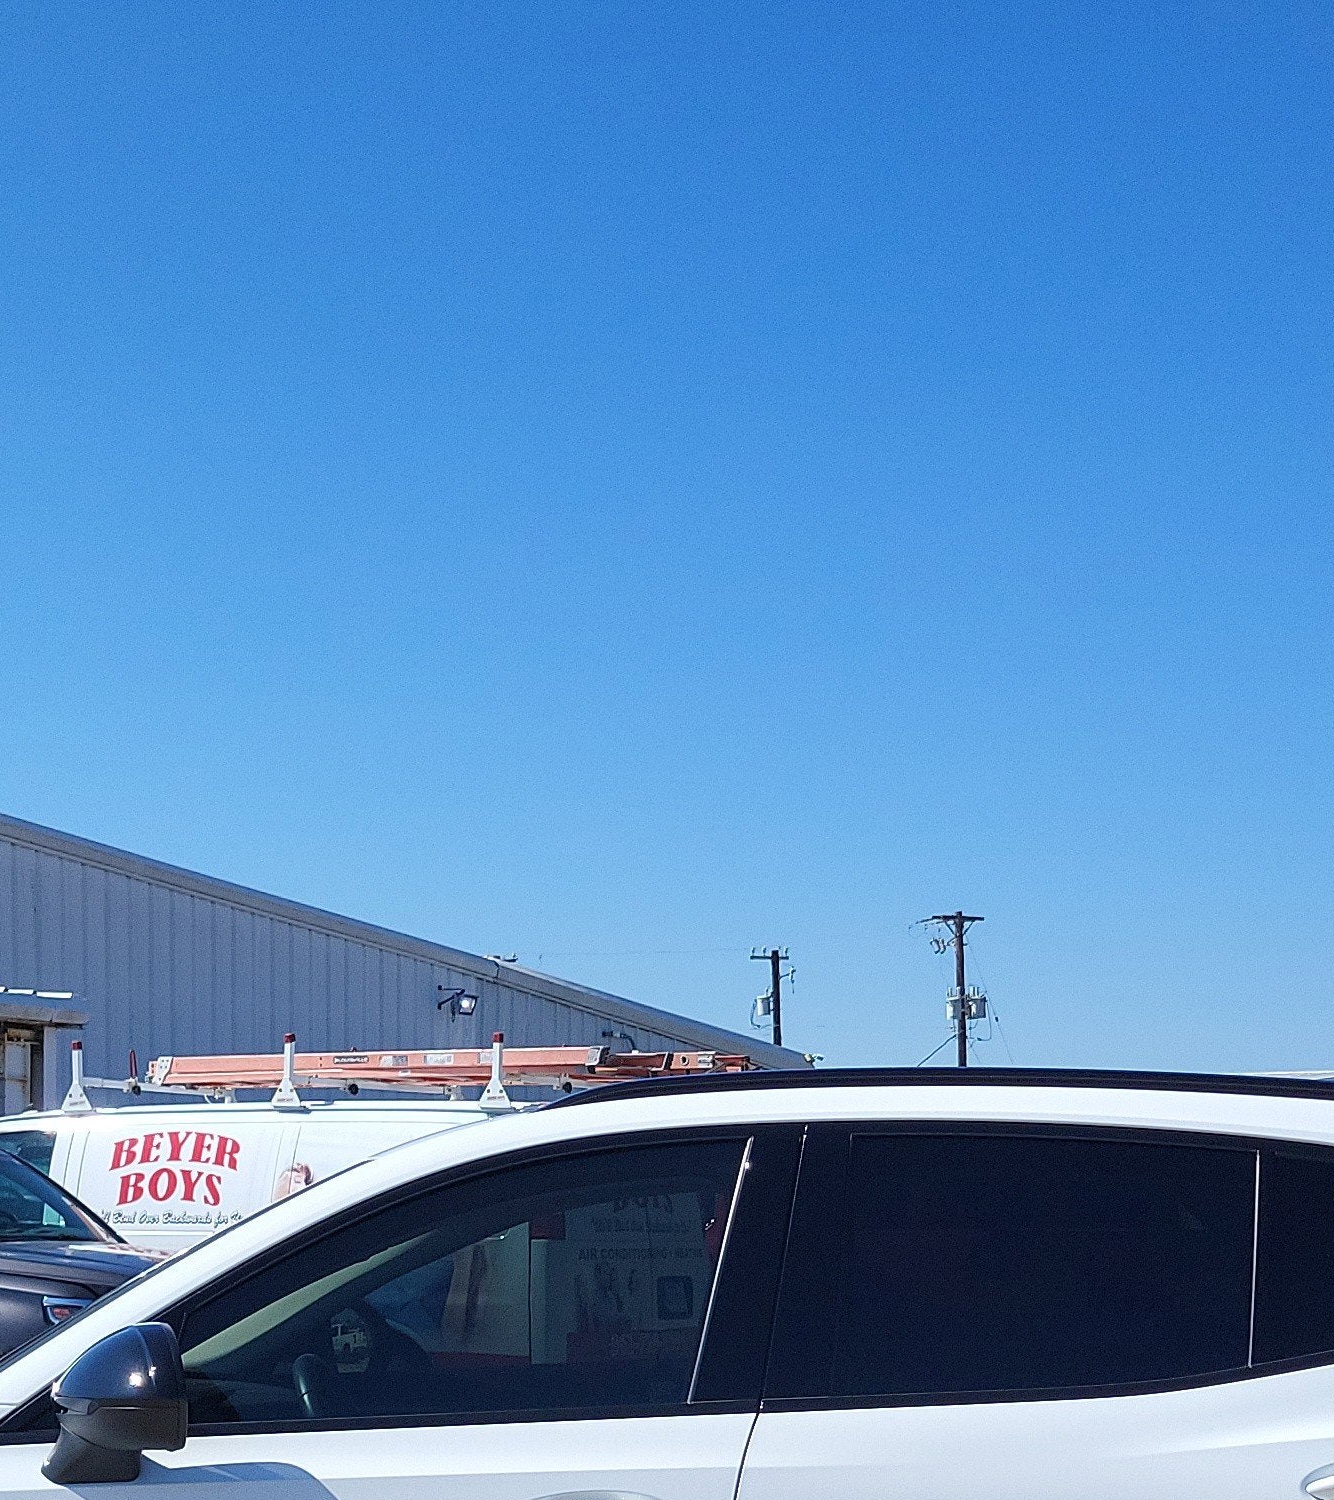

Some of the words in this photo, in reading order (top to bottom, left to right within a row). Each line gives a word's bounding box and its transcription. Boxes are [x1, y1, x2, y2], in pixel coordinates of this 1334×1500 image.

[109, 1131, 241, 1171] BEYER
[116, 1168, 222, 1206] BOYS
[113, 1211, 137, 1224] Bend
[139, 1210, 159, 1224] Over
[162, 1210, 212, 1224] Backwards
[214, 1211, 228, 1228] for
[578, 1248, 598, 1260] AIR
